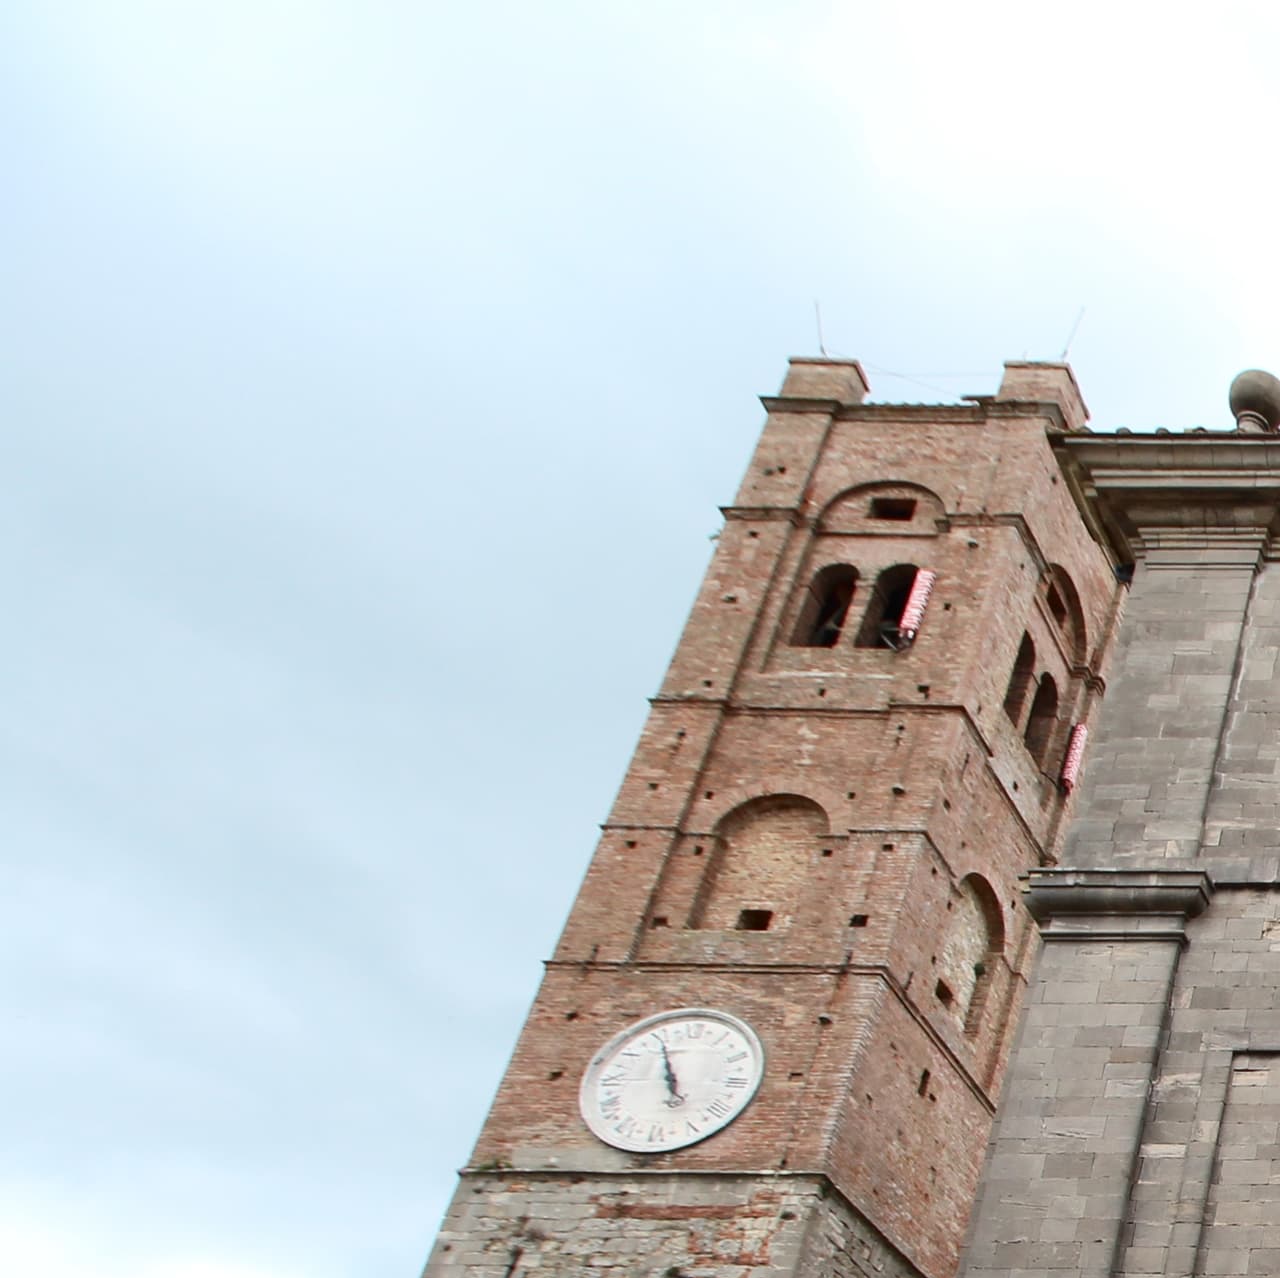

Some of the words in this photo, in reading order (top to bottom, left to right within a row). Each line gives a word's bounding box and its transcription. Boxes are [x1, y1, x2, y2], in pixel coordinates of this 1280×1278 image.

[712, 1031, 730, 1047] I
[726, 1052, 748, 1064] II
[724, 1077, 749, 1088] III
[686, 1120, 700, 1136] V
